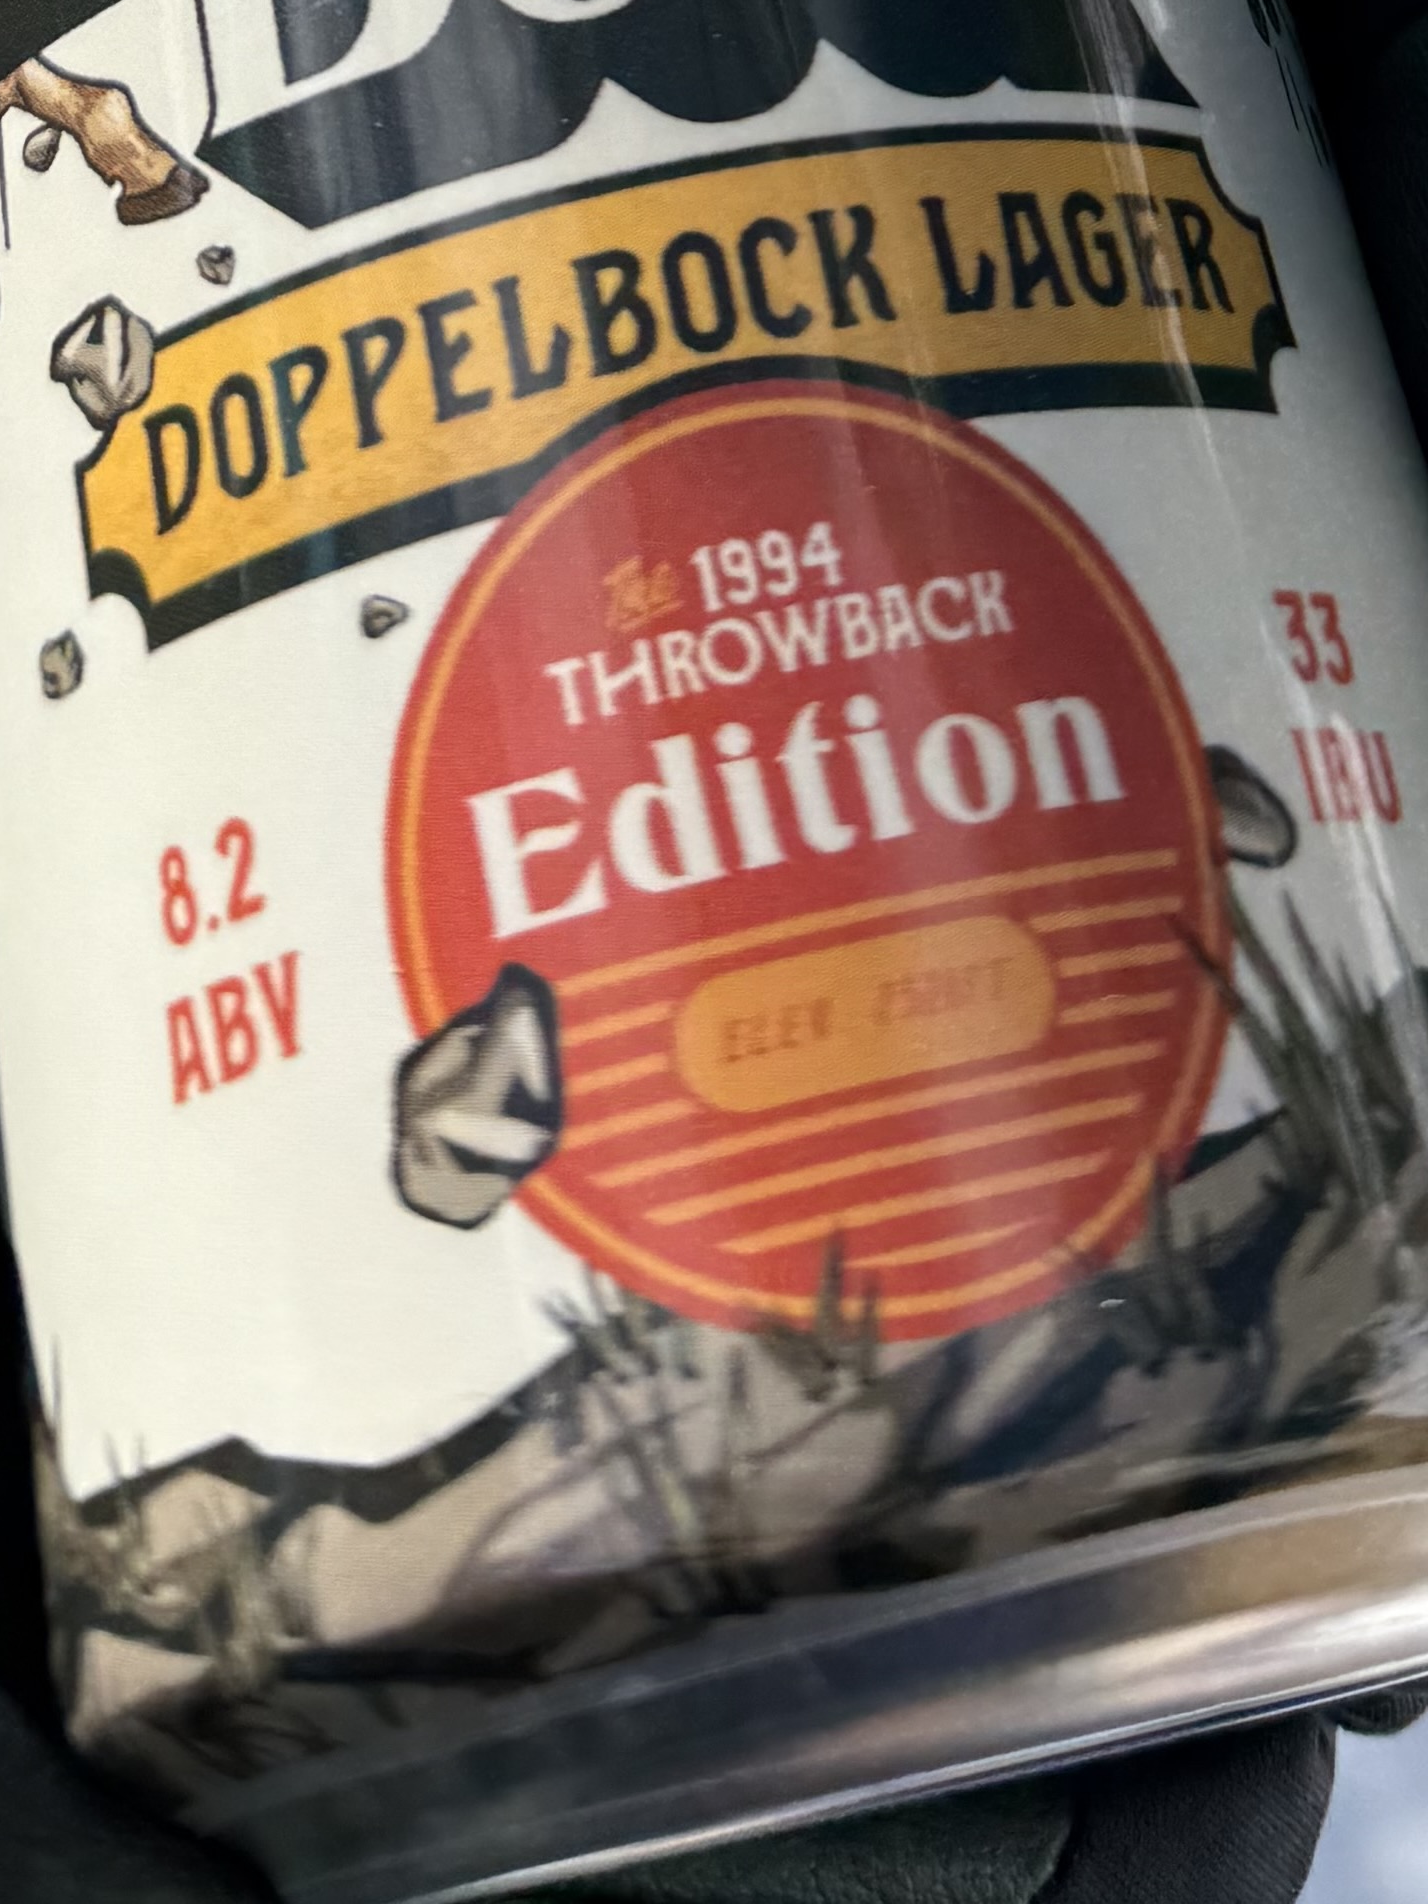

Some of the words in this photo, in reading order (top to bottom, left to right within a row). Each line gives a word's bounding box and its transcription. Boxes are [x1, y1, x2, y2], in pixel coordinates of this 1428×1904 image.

[143, 205, 896, 535] DOPPELBOCK
[922, 190, 1235, 314] LAGER
[688, 520, 844, 613] 1994
[1272, 588, 1355, 685] 33
[544, 570, 1014, 726] THROWBACK
[465, 692, 1123, 939] Edition
[1290, 726, 1403, 825] IBU
[159, 815, 267, 948] 8.2
[166, 949, 302, 1105] ABV
